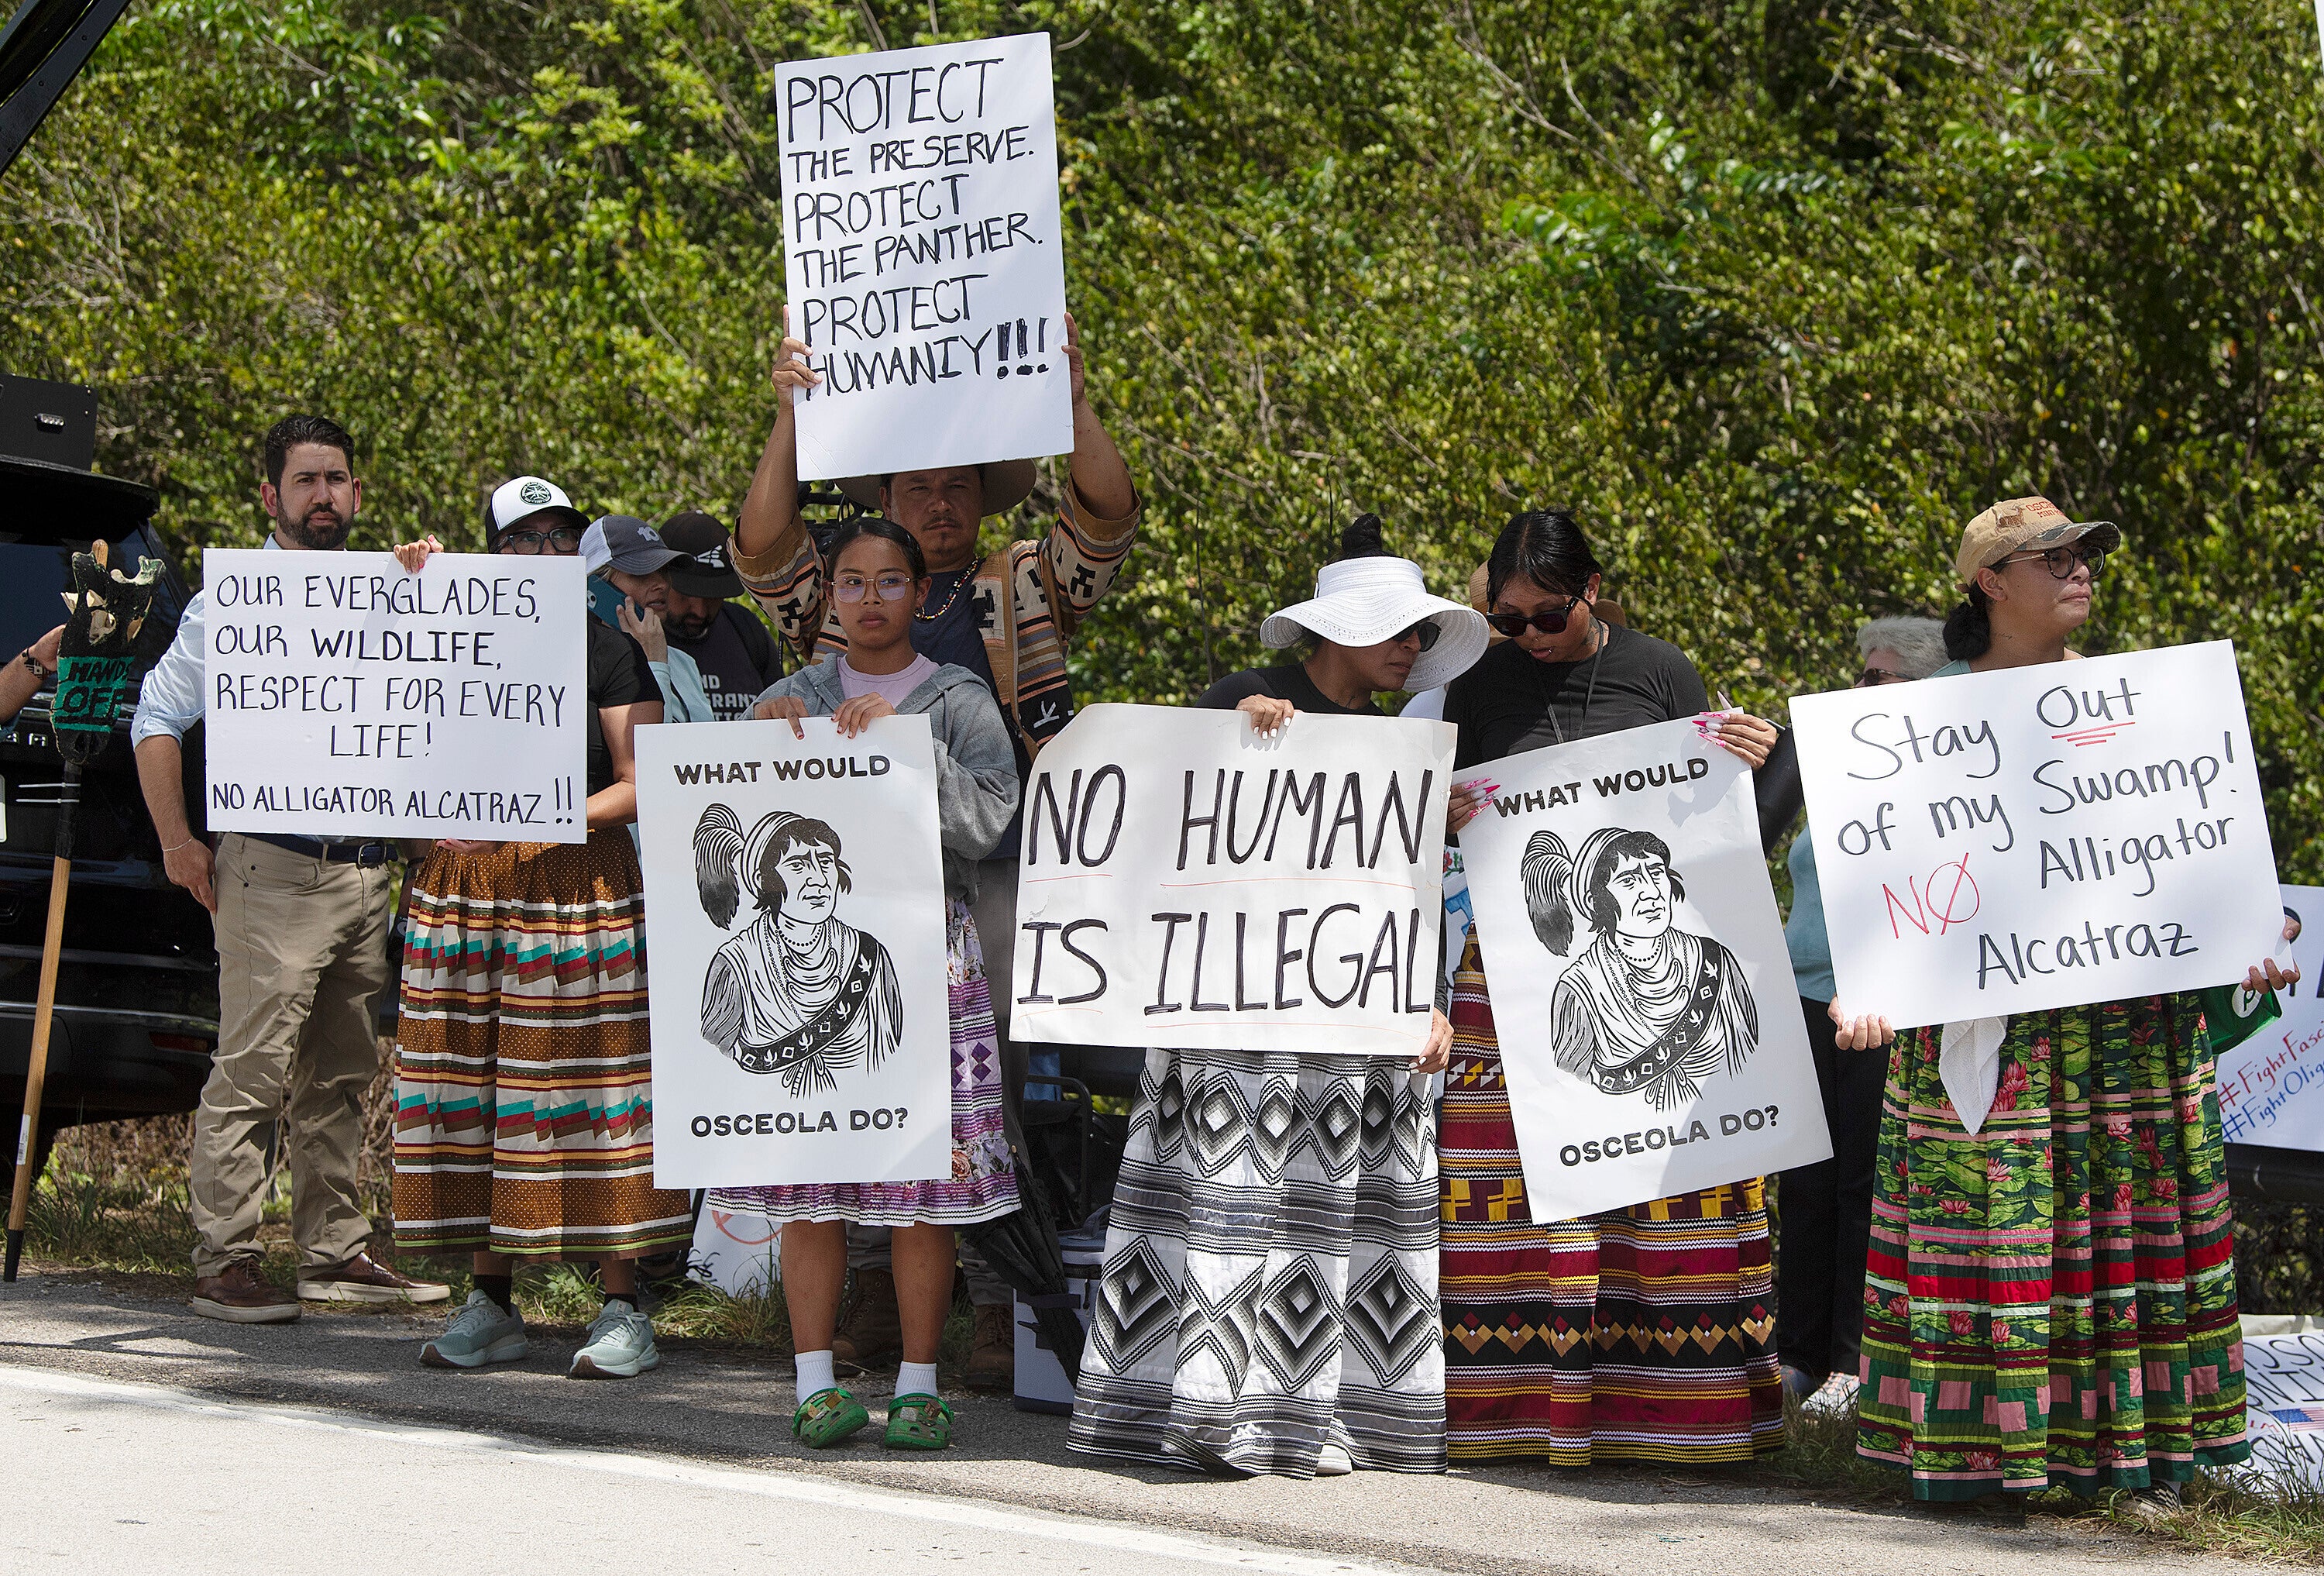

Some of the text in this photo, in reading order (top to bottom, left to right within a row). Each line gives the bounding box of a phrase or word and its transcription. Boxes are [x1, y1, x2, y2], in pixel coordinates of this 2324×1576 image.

[787, 57, 1004, 143] PROTECT
[788, 125, 1033, 182] THE PRESERVE.
[795, 173, 970, 243] PROTECT
[794, 212, 1043, 287] THE PANTHER.
[803, 274, 988, 347] PROTECT
[217, 575, 540, 623] OUR EVERGLADES,
[216, 625, 501, 669] OUR WILDLIFE,
[62, 686, 124, 724] OFF
[218, 673, 566, 727] RESPECT FOR EVERY
[1848, 678, 2142, 779] Stay Out
[331, 722, 431, 758] LIFE!
[673, 755, 891, 786] WHAT WOULD
[213, 783, 244, 810] NO
[253, 785, 394, 817] ALLIGATOR
[405, 790, 547, 824] ALCATRAZ
[1027, 764, 1433, 871] NO HUMAN
[1493, 758, 1709, 818] WHAT WOULD
[1838, 731, 2237, 855] of my Swamp!
[2040, 817, 2234, 897] Alligator
[1017, 903, 1431, 1016] IS ILLEGAL
[1976, 920, 2199, 990] Alcatraz
[2218, 1020, 2324, 1113] #FightFasc
[690, 1107, 908, 1137] OSCEOLA DO?
[1559, 1104, 1779, 1167] OSCEOLA DO?
